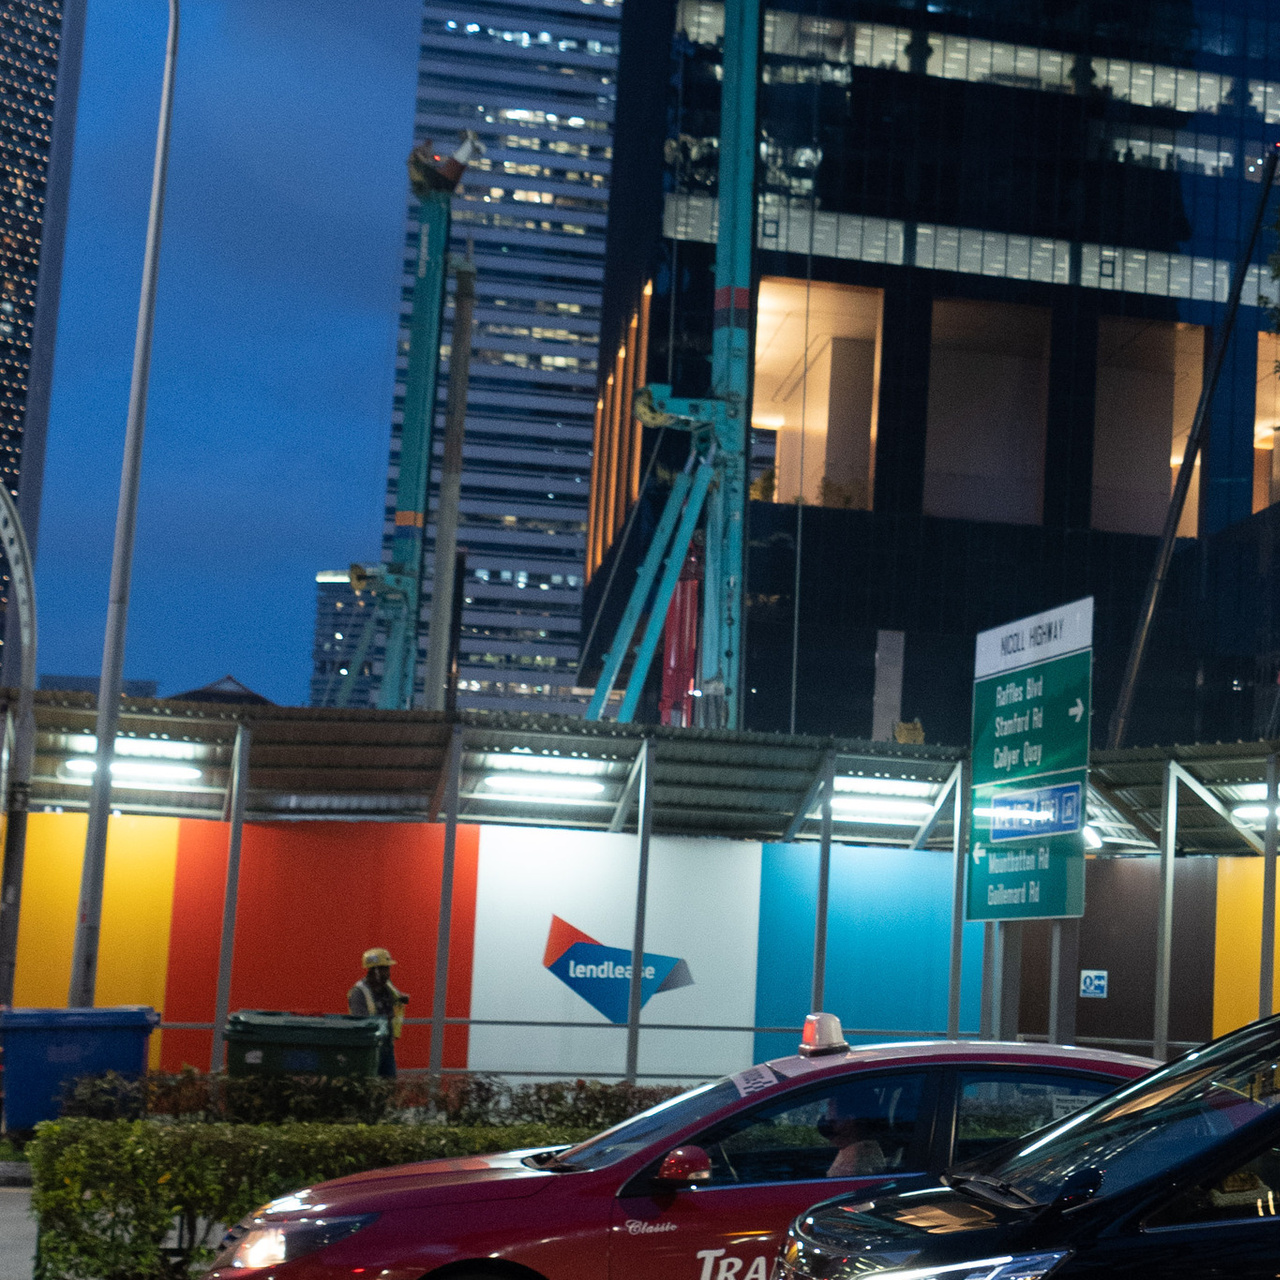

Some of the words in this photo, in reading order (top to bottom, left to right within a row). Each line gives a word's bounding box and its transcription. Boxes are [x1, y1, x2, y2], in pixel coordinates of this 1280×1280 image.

[1001, 631, 1025, 656] NICOLL
[1029, 618, 1064, 648] HIGHWAY
[996, 682, 1024, 708] Raffles
[1026, 676, 1043, 700] Blvd
[995, 709, 1030, 738] Stamford
[1032, 706, 1043, 729] Rd
[993, 745, 1020, 773] Collyer
[1023, 740, 1043, 768] Quay
[988, 850, 1036, 875] Mountbatten
[1038, 846, 1050, 870] Rd
[987, 882, 1027, 907] Guillemard
[1029, 880, 1040, 904] Rd
[625, 1219, 678, 1236] Classic
